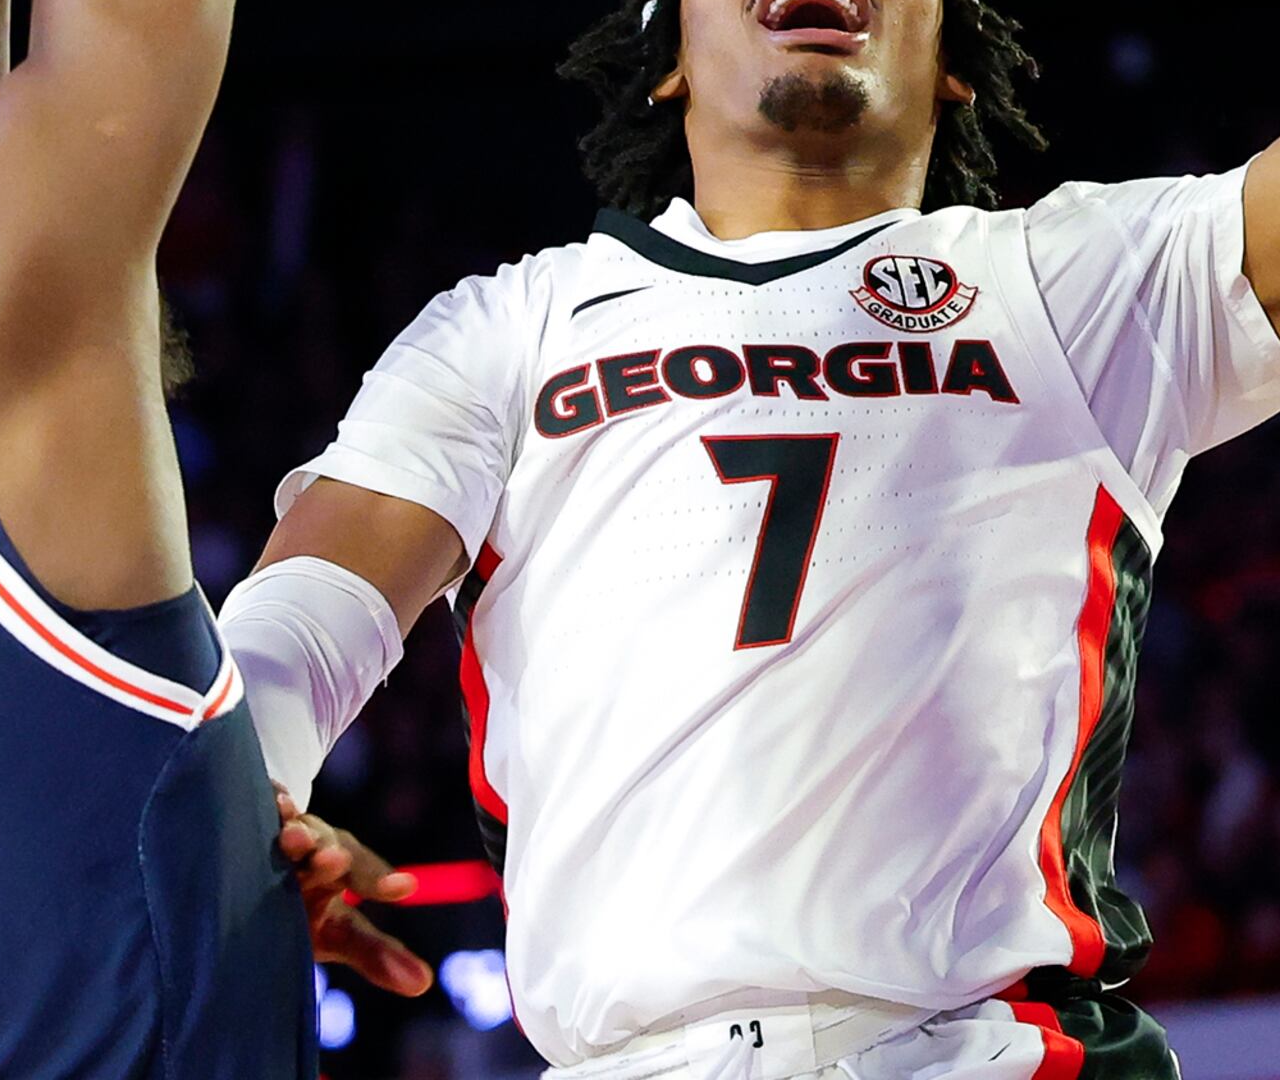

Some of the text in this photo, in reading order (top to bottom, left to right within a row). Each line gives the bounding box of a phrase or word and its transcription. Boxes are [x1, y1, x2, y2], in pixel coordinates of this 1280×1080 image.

[867, 300, 964, 330] GRADUATE
[870, 257, 949, 308] SEC
[534, 339, 1021, 438] GEORGIA
[700, 432, 840, 651] 7
